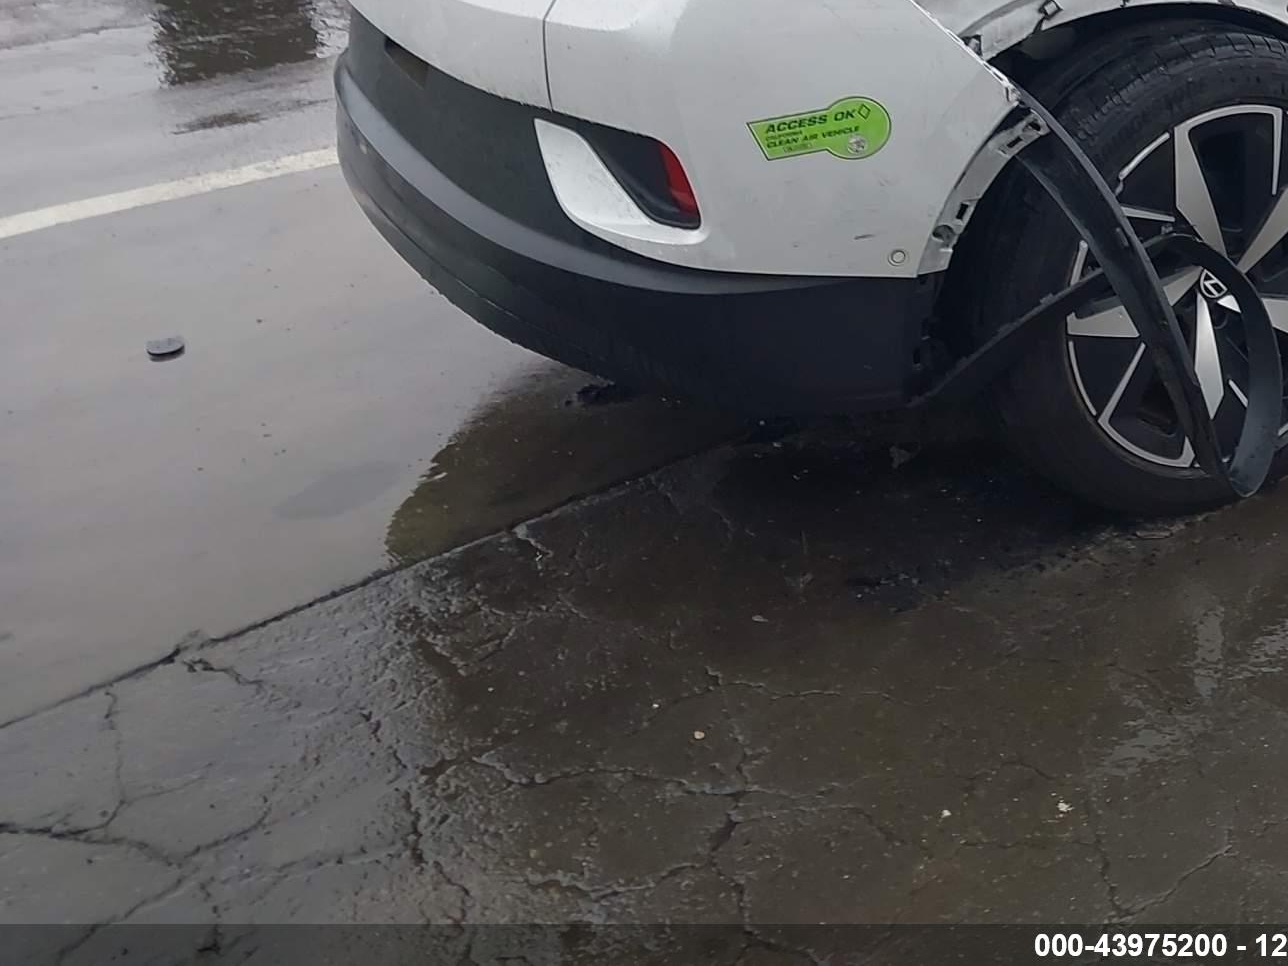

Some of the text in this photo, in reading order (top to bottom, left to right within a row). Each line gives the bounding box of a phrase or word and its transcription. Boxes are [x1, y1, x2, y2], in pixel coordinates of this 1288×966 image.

[765, 109, 856, 134] ACCESS OK
[766, 137, 799, 149] CLEAN
[802, 133, 818, 142] AIR
[822, 126, 860, 139] VEHICLE
